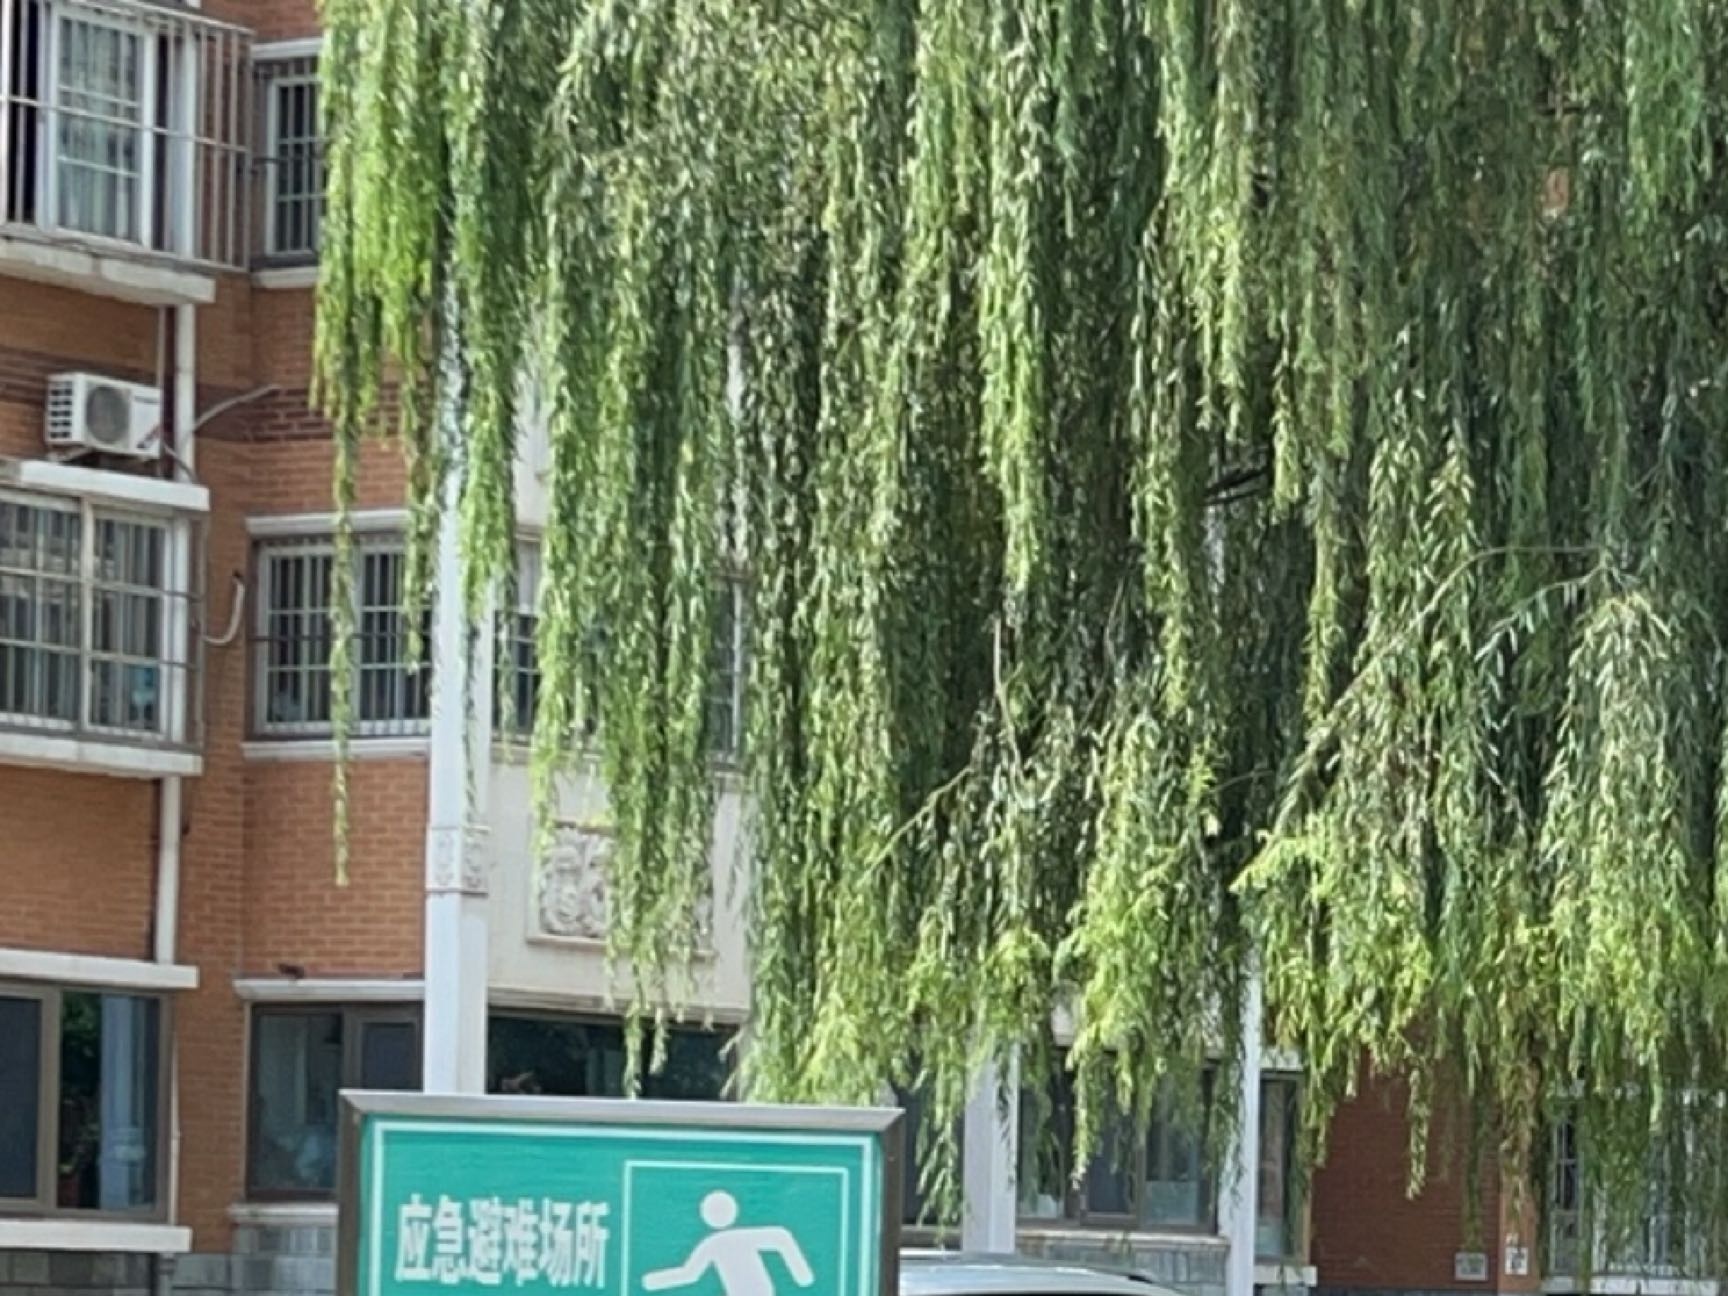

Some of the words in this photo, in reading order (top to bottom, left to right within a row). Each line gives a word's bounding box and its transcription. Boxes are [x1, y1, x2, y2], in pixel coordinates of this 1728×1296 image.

[394, 1193, 609, 1288] 应急避难场所
